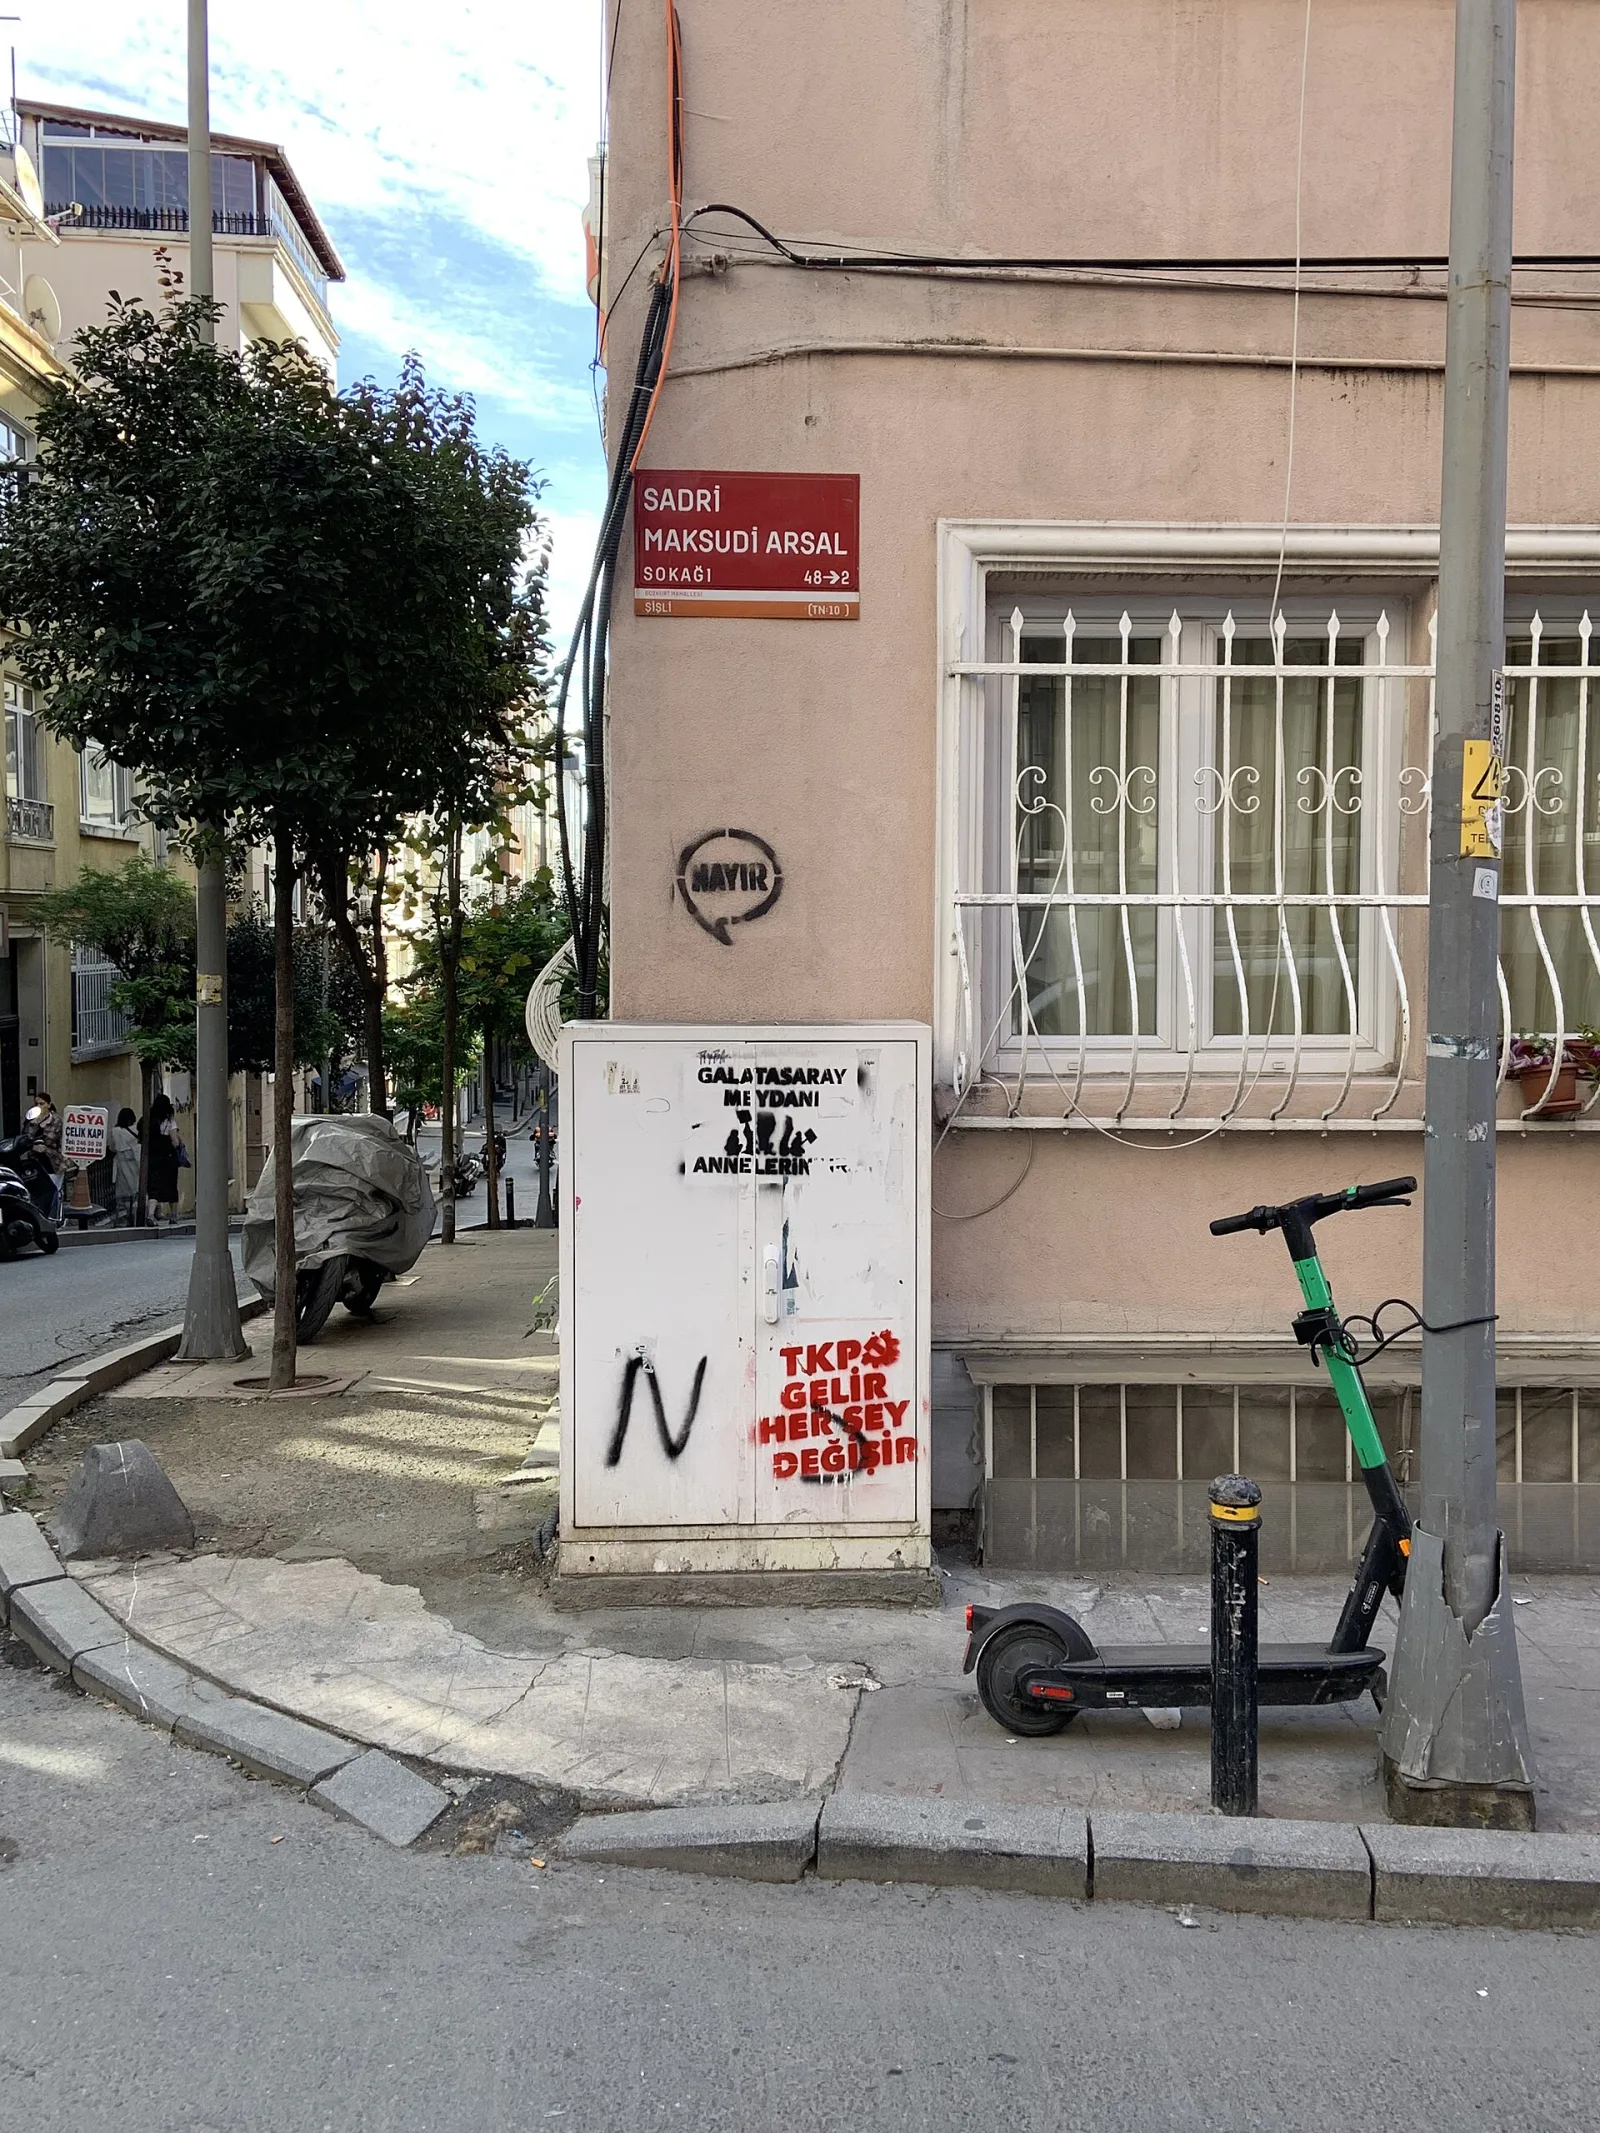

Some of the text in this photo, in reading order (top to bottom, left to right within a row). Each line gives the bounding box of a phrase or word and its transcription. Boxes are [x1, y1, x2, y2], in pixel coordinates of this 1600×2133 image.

[643, 485, 721, 512] SADRİ
[644, 526, 848, 555] MAKSUDİ ARSAL
[643, 566, 712, 583] SOKAĞI
[644, 600, 672, 614] ŞİŞLİ
[692, 863, 768, 892] HAYIR
[697, 1067, 848, 1085] GALATASARAY
[723, 1089, 820, 1107] MEYDANI
[67, 1113, 104, 1126] ASYA
[87, 1128, 104, 1139] KAPI
[779, 1339, 862, 1376] TKP
[780, 1366, 888, 1410] GELİR
[759, 1410, 834, 1444] HER
[772, 1430, 919, 1479] DEĞİŞİR
